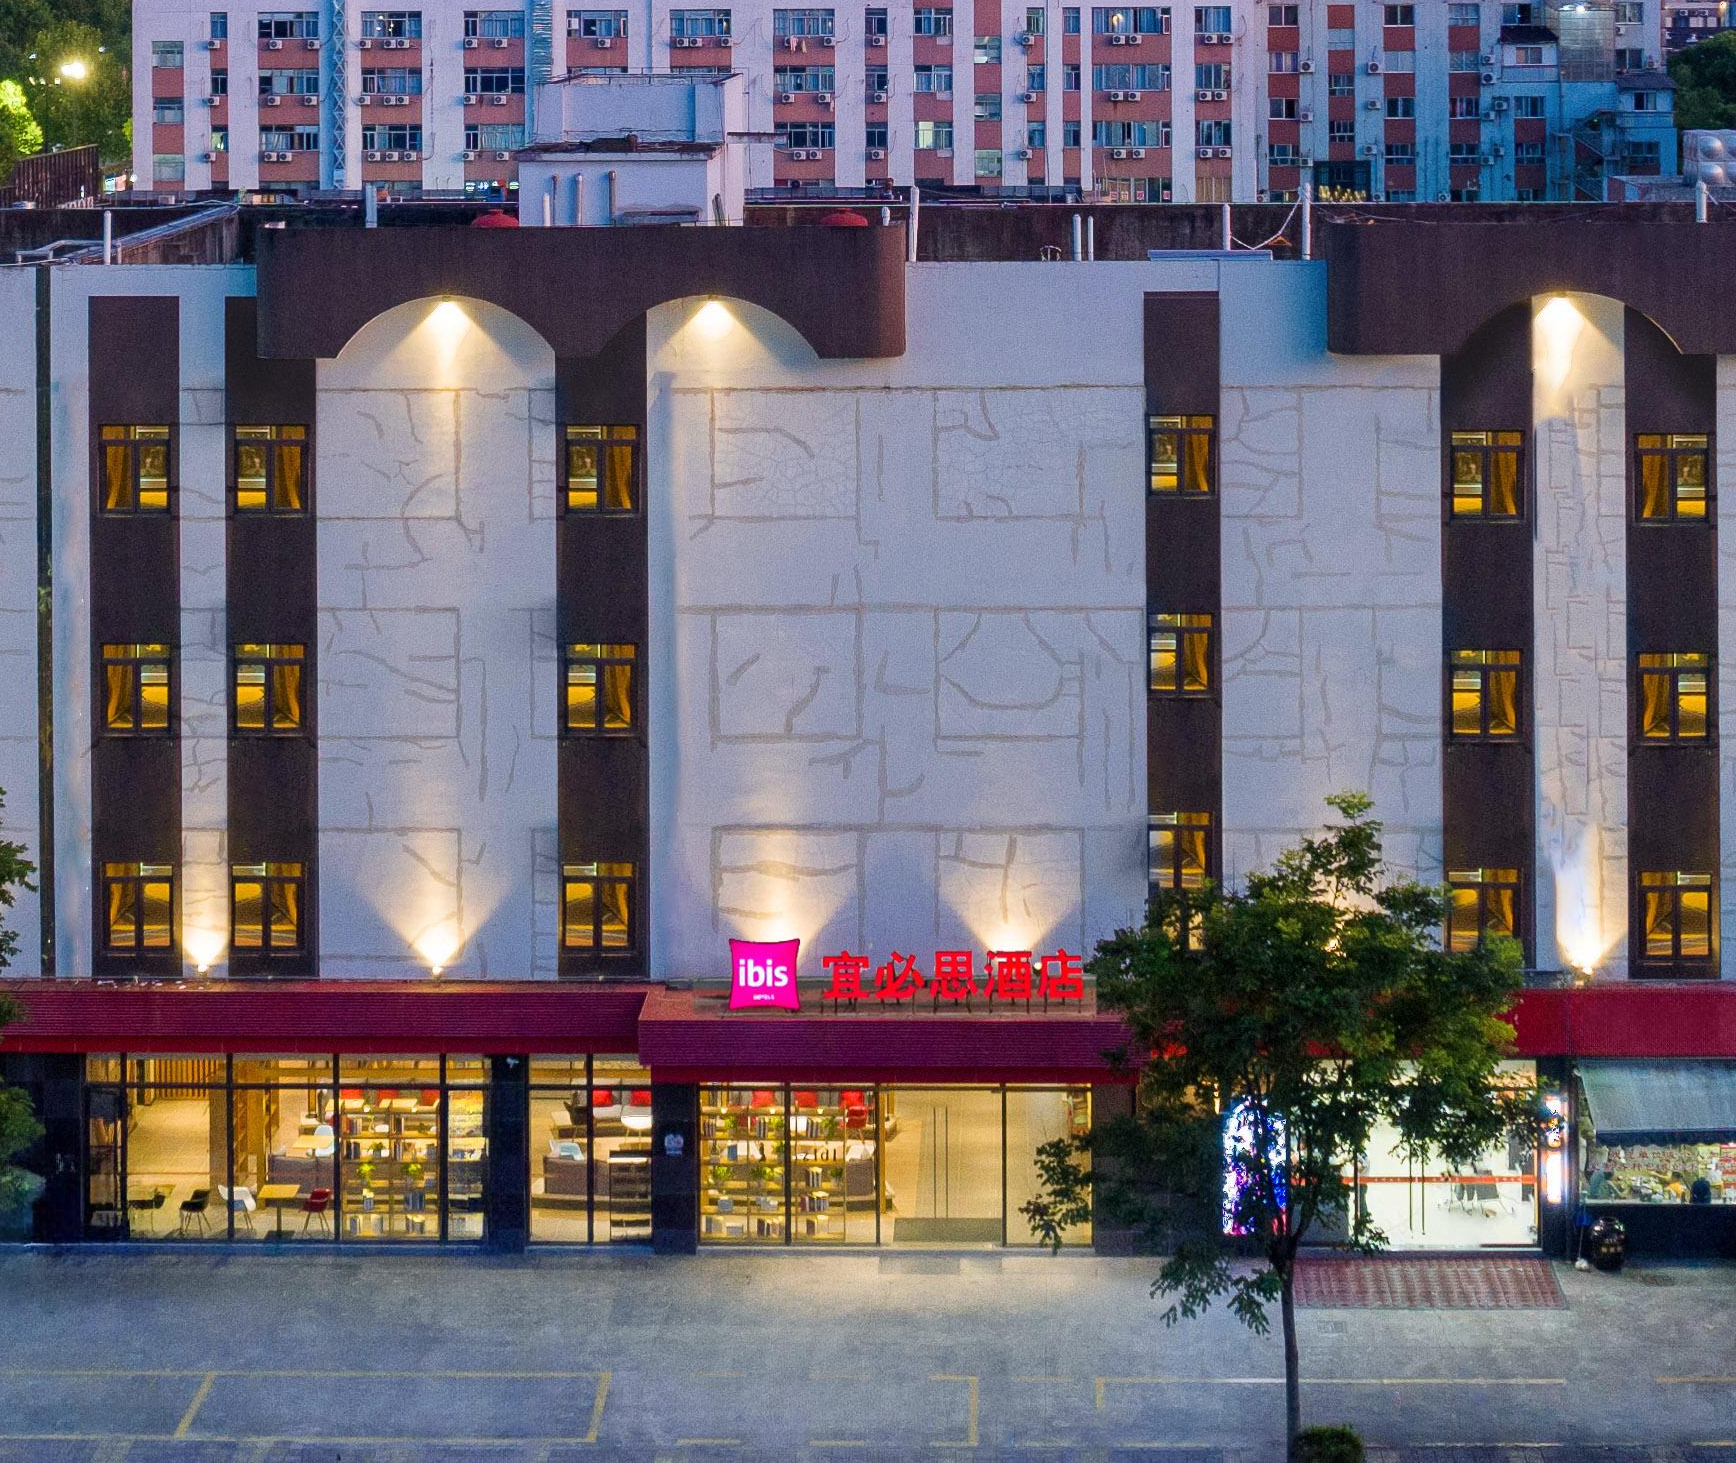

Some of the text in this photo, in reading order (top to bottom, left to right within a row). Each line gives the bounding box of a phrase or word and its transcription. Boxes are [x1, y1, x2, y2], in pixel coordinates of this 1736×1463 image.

[739, 959, 788, 987] ibis
[822, 948, 1084, 999] 宜必思酒店
